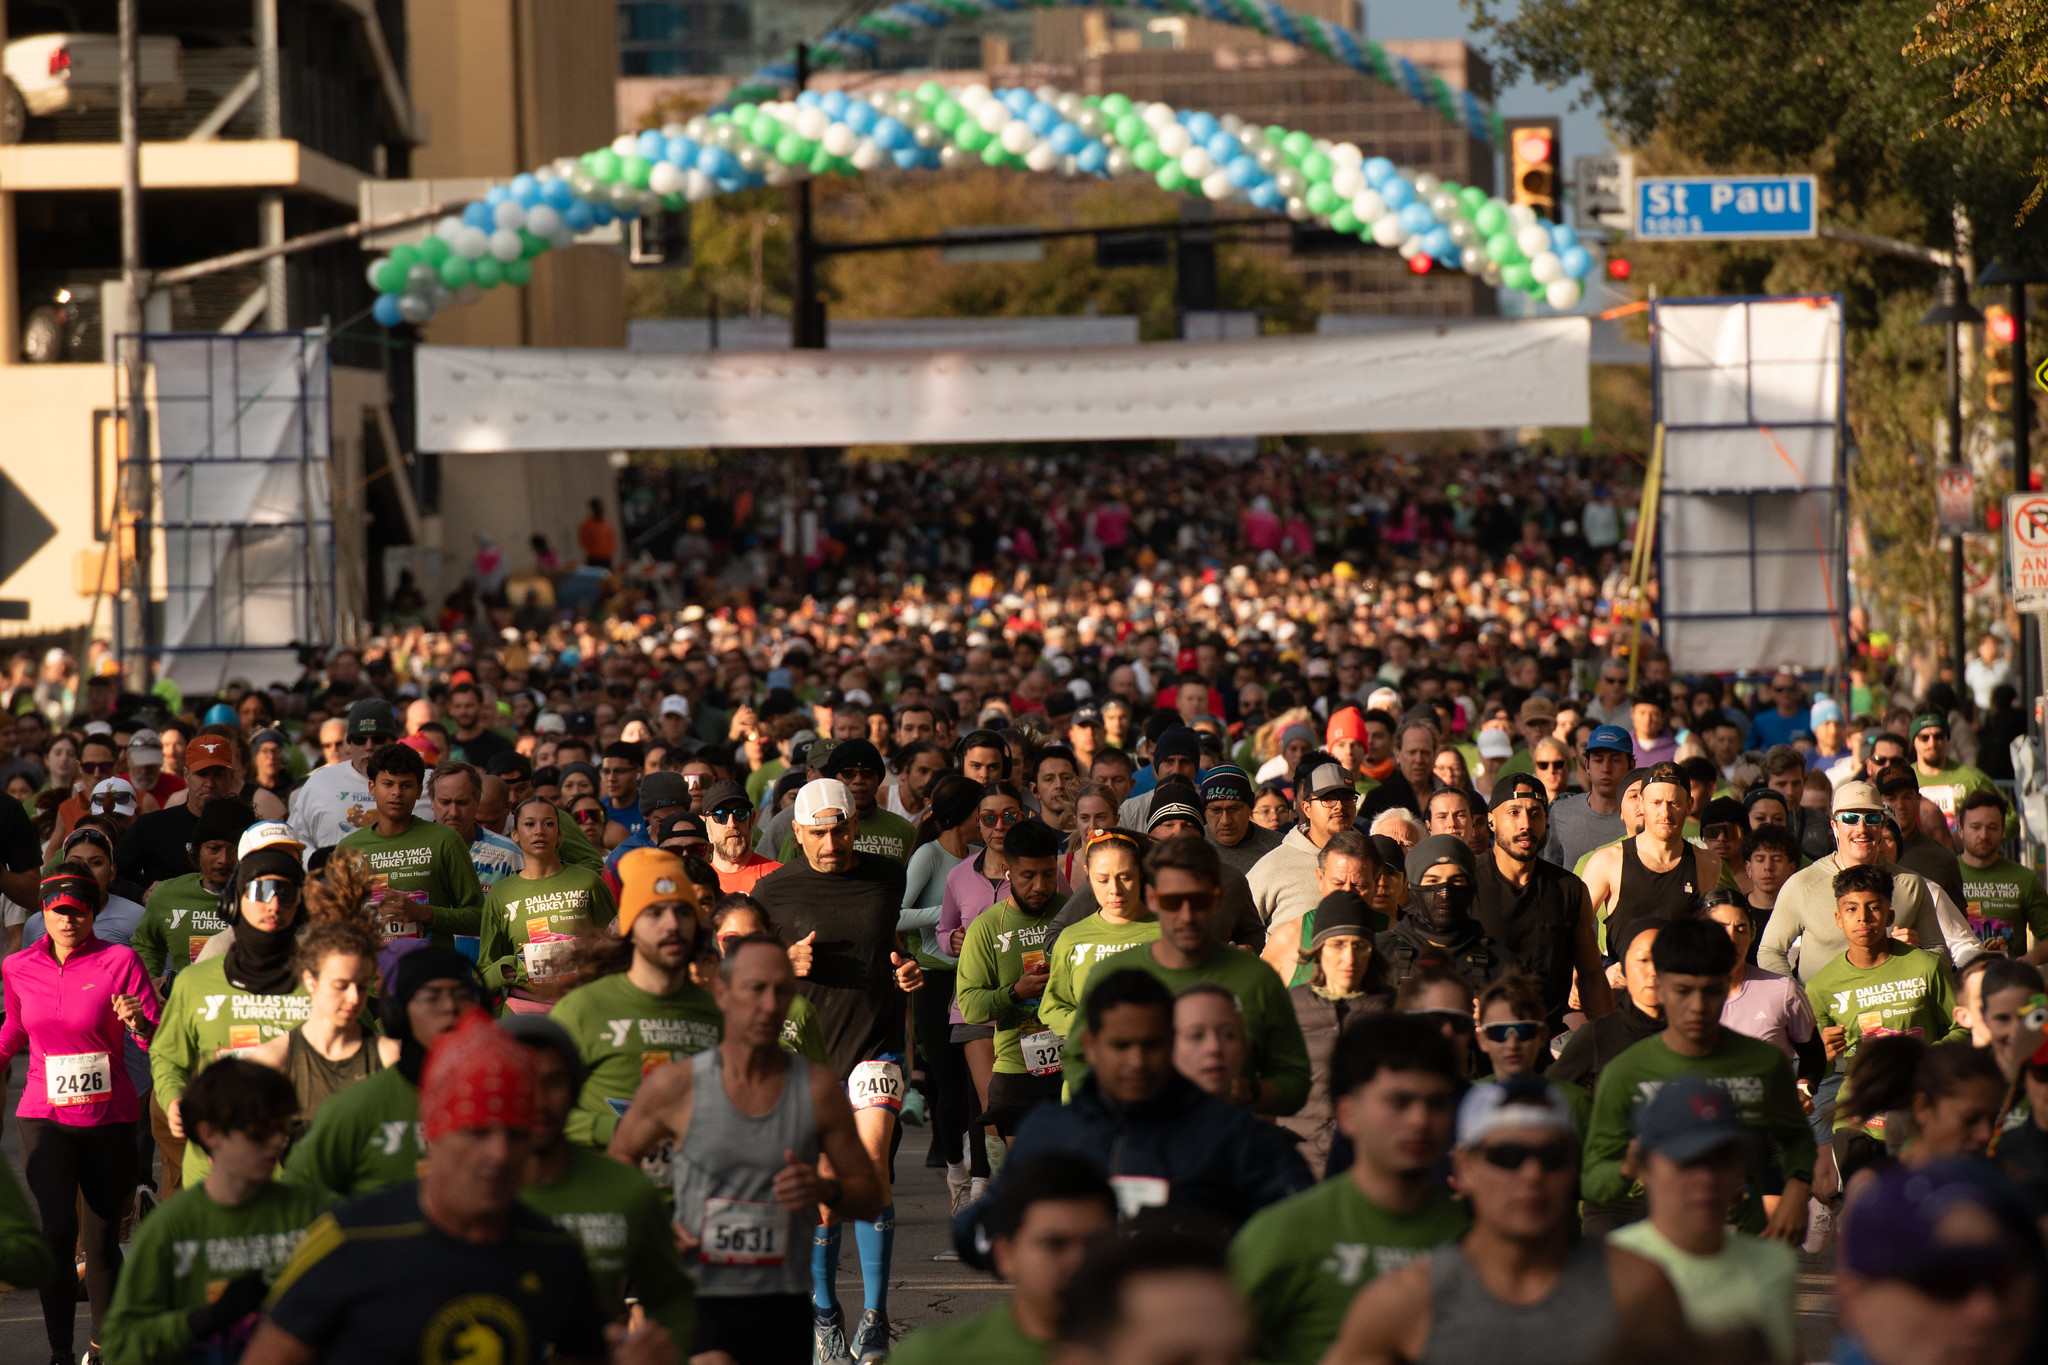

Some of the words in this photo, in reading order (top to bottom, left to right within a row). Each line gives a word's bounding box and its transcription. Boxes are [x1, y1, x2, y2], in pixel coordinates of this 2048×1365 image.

[1648, 184, 1688, 215] St
[1711, 181, 1802, 214] Paul
[2021, 556, 2048, 571] AN
[2020, 574, 2048, 588] TIM
[1207, 786, 1238, 796] BUM
[879, 836, 903, 848] YMCA
[371, 851, 404, 862] DALLAS
[405, 846, 432, 857] YMCA
[882, 845, 903, 858] TROT
[371, 858, 406, 869] TURKEY
[407, 856, 432, 865] TROT
[1962, 882, 1994, 890] DALLAS
[525, 892, 562, 906] DALLAS
[562, 890, 590, 900] YMCA
[1963, 890, 1996, 898] TURKEY
[1996, 890, 2020, 898] TROT
[526, 900, 564, 914] TURKEY
[566, 899, 588, 908] TROT
[192, 910, 220, 920] DALL
[1017, 924, 1048, 938] DALLA
[1855, 982, 1894, 999] DALLAS
[1894, 977, 1926, 990] YMCA
[232, 994, 282, 1007] DALLAS
[282, 995, 312, 1008] YMC
[1856, 992, 1898, 1008] TURKEY
[1899, 986, 1927, 1000] TROT
[232, 1006, 284, 1020] TURKEY
[285, 1007, 312, 1020] TRO
[639, 1018, 688, 1032] DALLAS
[640, 1030, 692, 1045] TURKEY
[56, 1072, 103, 1094] 2426
[857, 1078, 898, 1098] 2402
[72, 1096, 90, 1104] 2025
[716, 1224, 774, 1252] 5631
